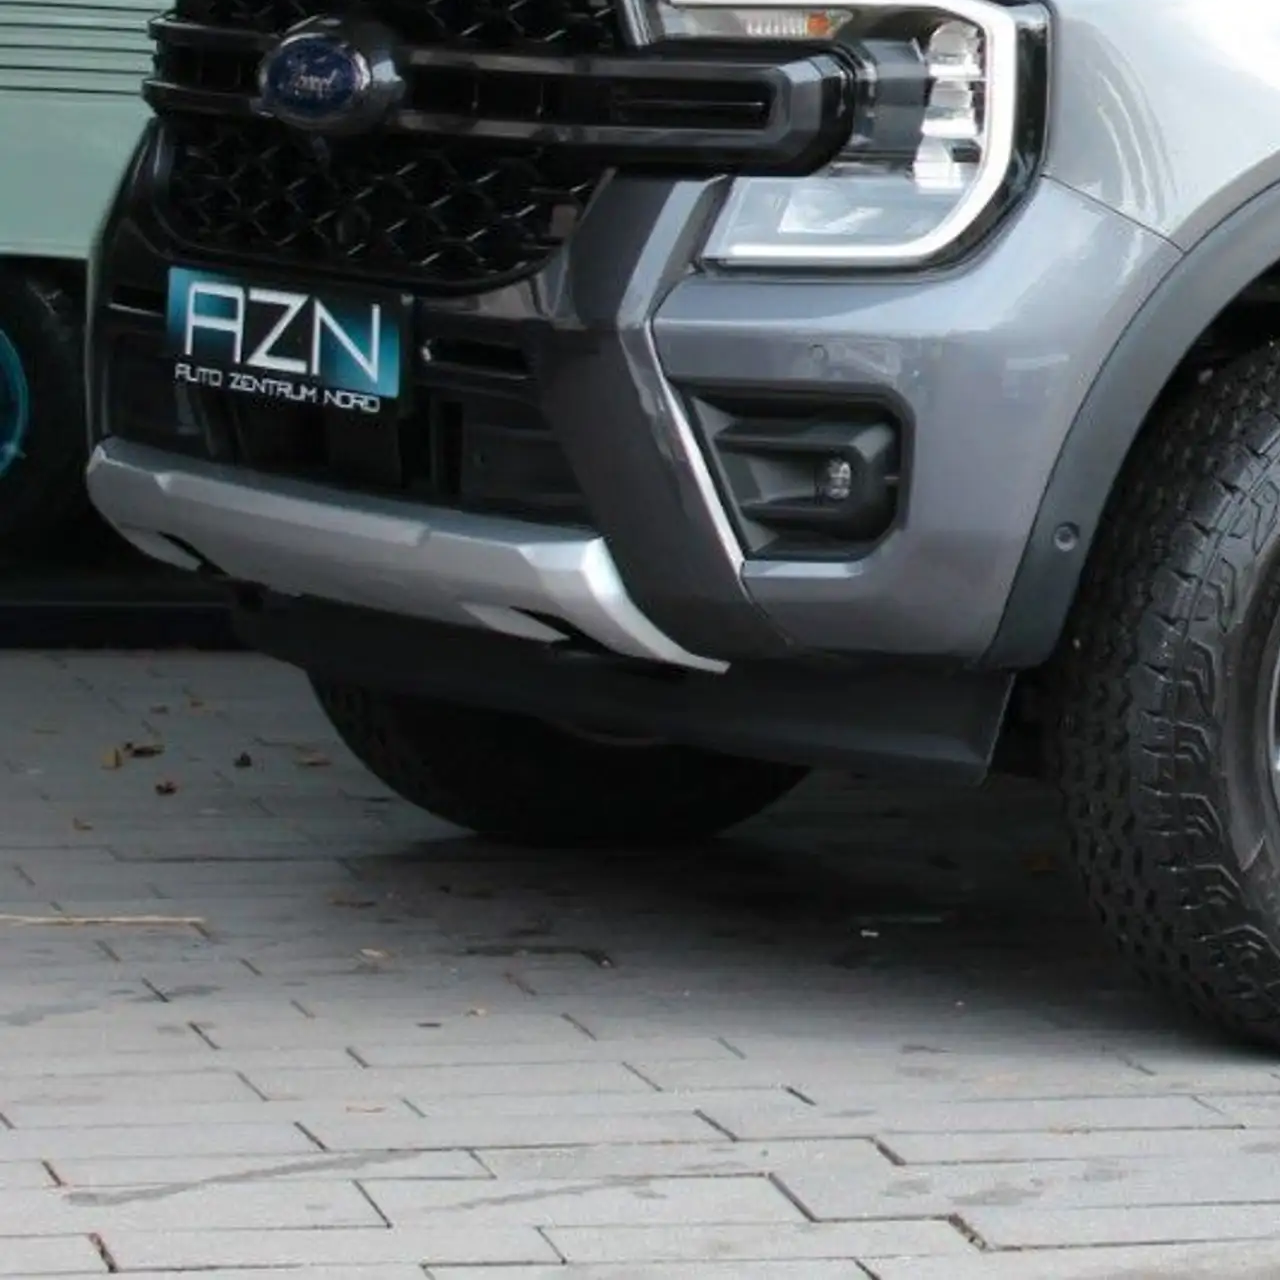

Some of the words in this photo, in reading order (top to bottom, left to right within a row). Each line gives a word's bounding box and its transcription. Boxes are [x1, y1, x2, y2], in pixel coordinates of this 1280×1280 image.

[184, 280, 381, 384] AZN
[174, 363, 223, 388] AUTO
[229, 372, 317, 404] ZENTRUM
[323, 389, 381, 414] NORD
